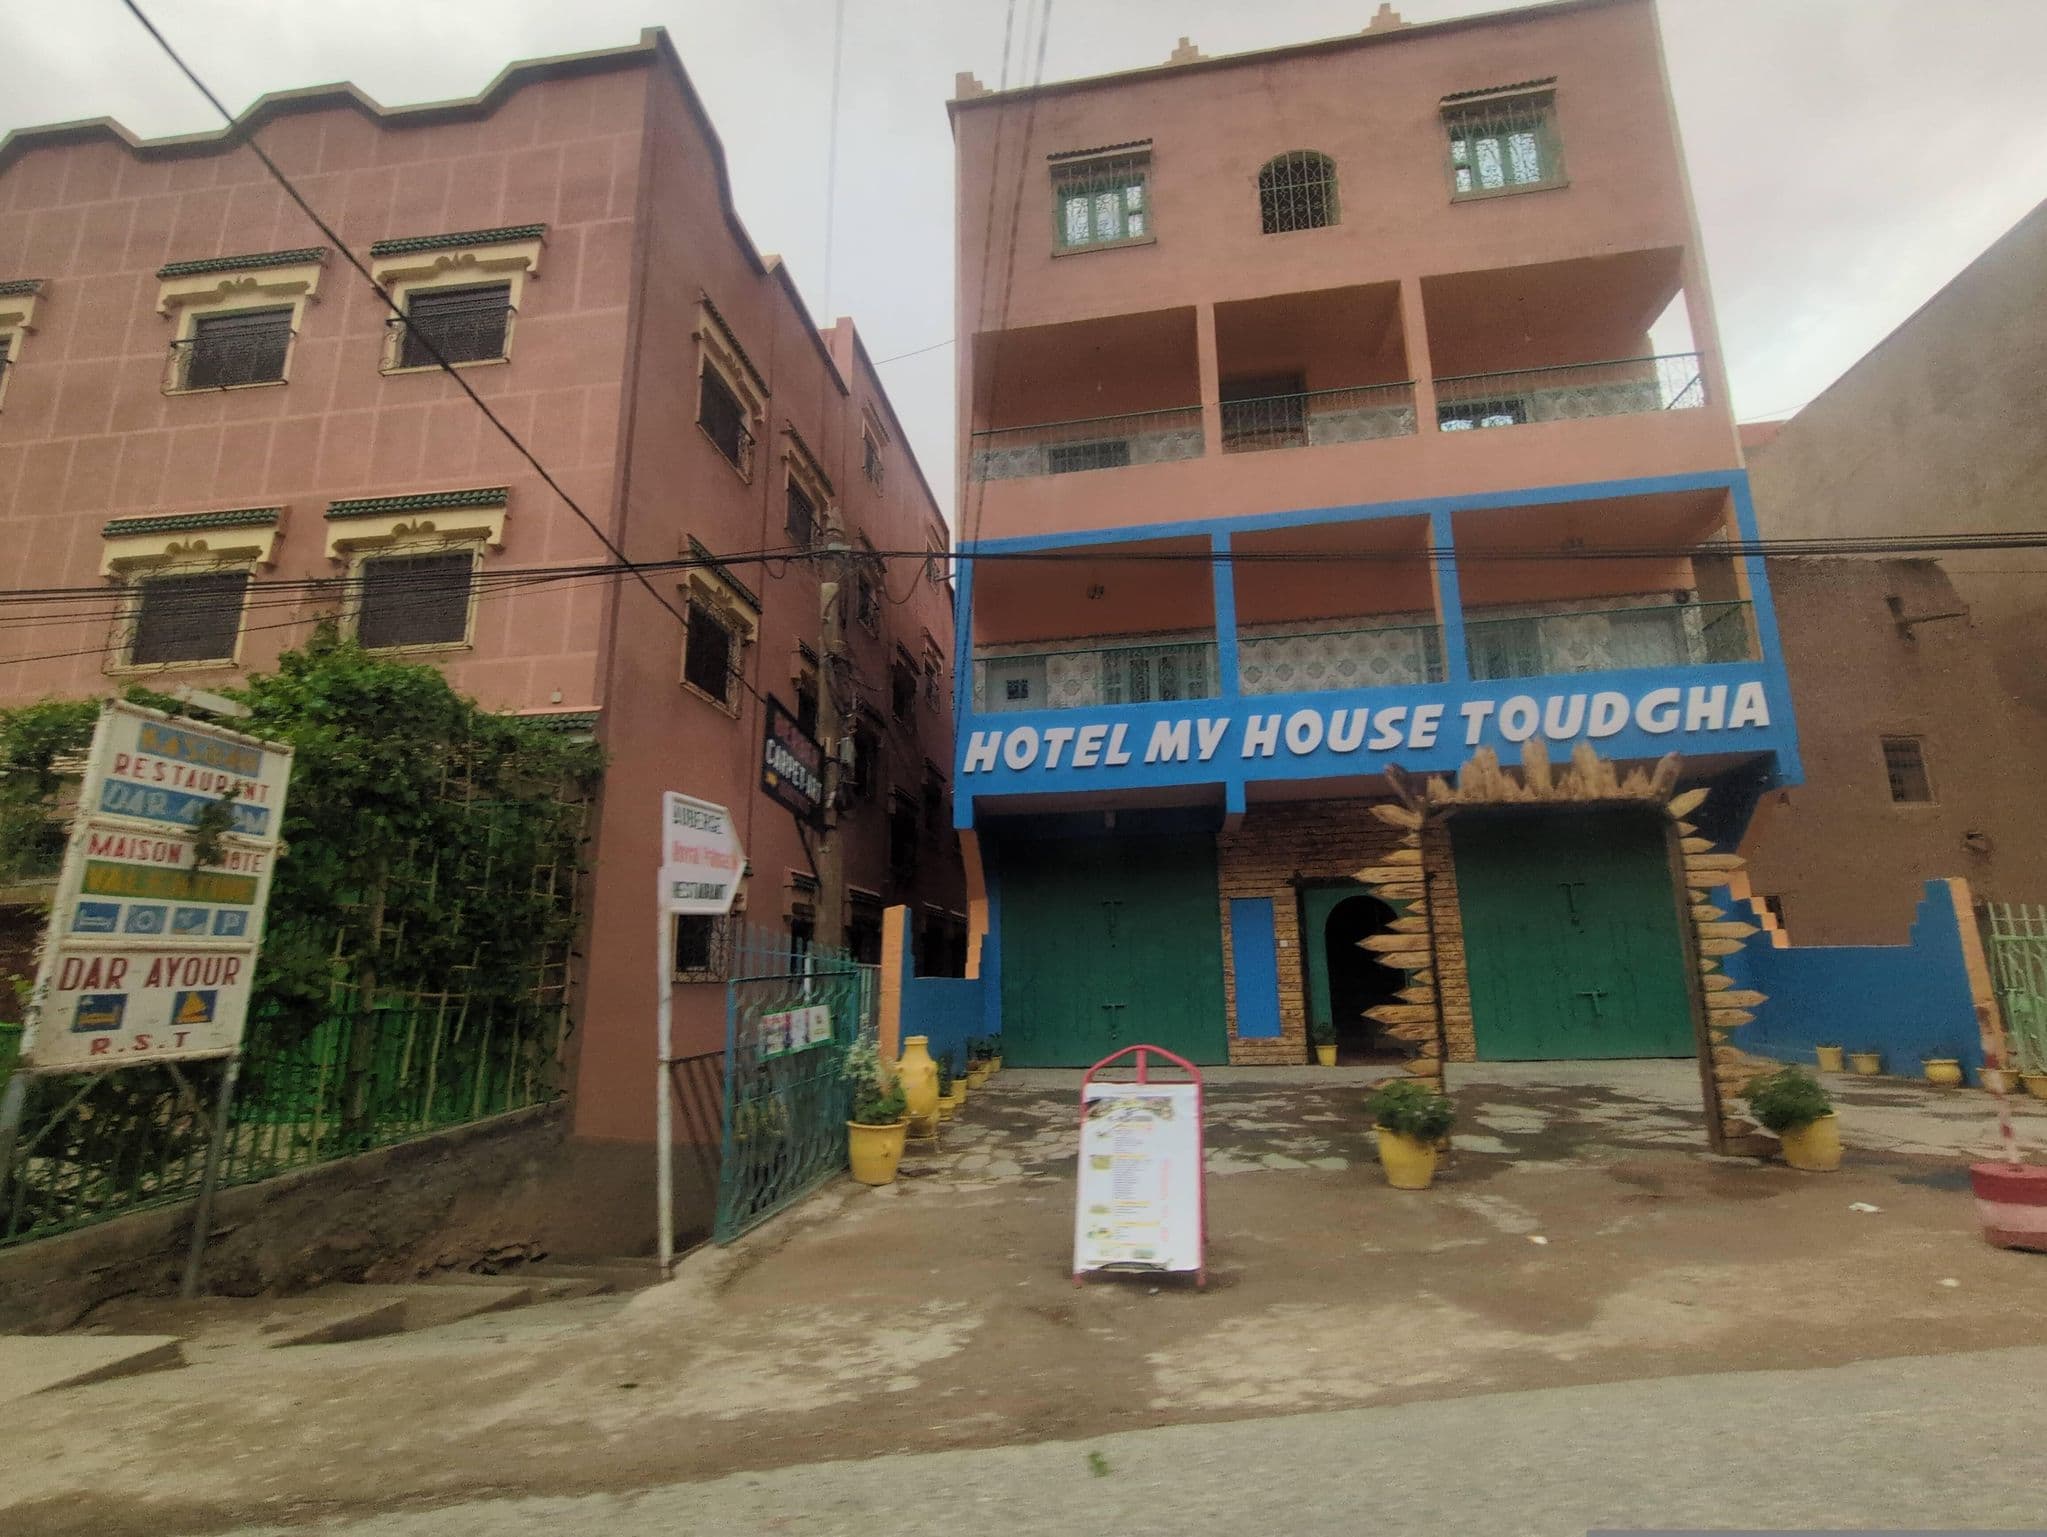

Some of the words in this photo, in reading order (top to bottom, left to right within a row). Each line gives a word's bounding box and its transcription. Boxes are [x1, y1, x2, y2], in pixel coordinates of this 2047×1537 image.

[963, 723, 1132, 773] HOTEL
[1144, 718, 1231, 764] MY
[1241, 703, 1446, 758] HOUSE
[1460, 681, 1771, 746] TOUDGHA
[88, 833, 183, 863] MAISON
[57, 957, 128, 991] DAR
[144, 956, 241, 988] AYOUR
